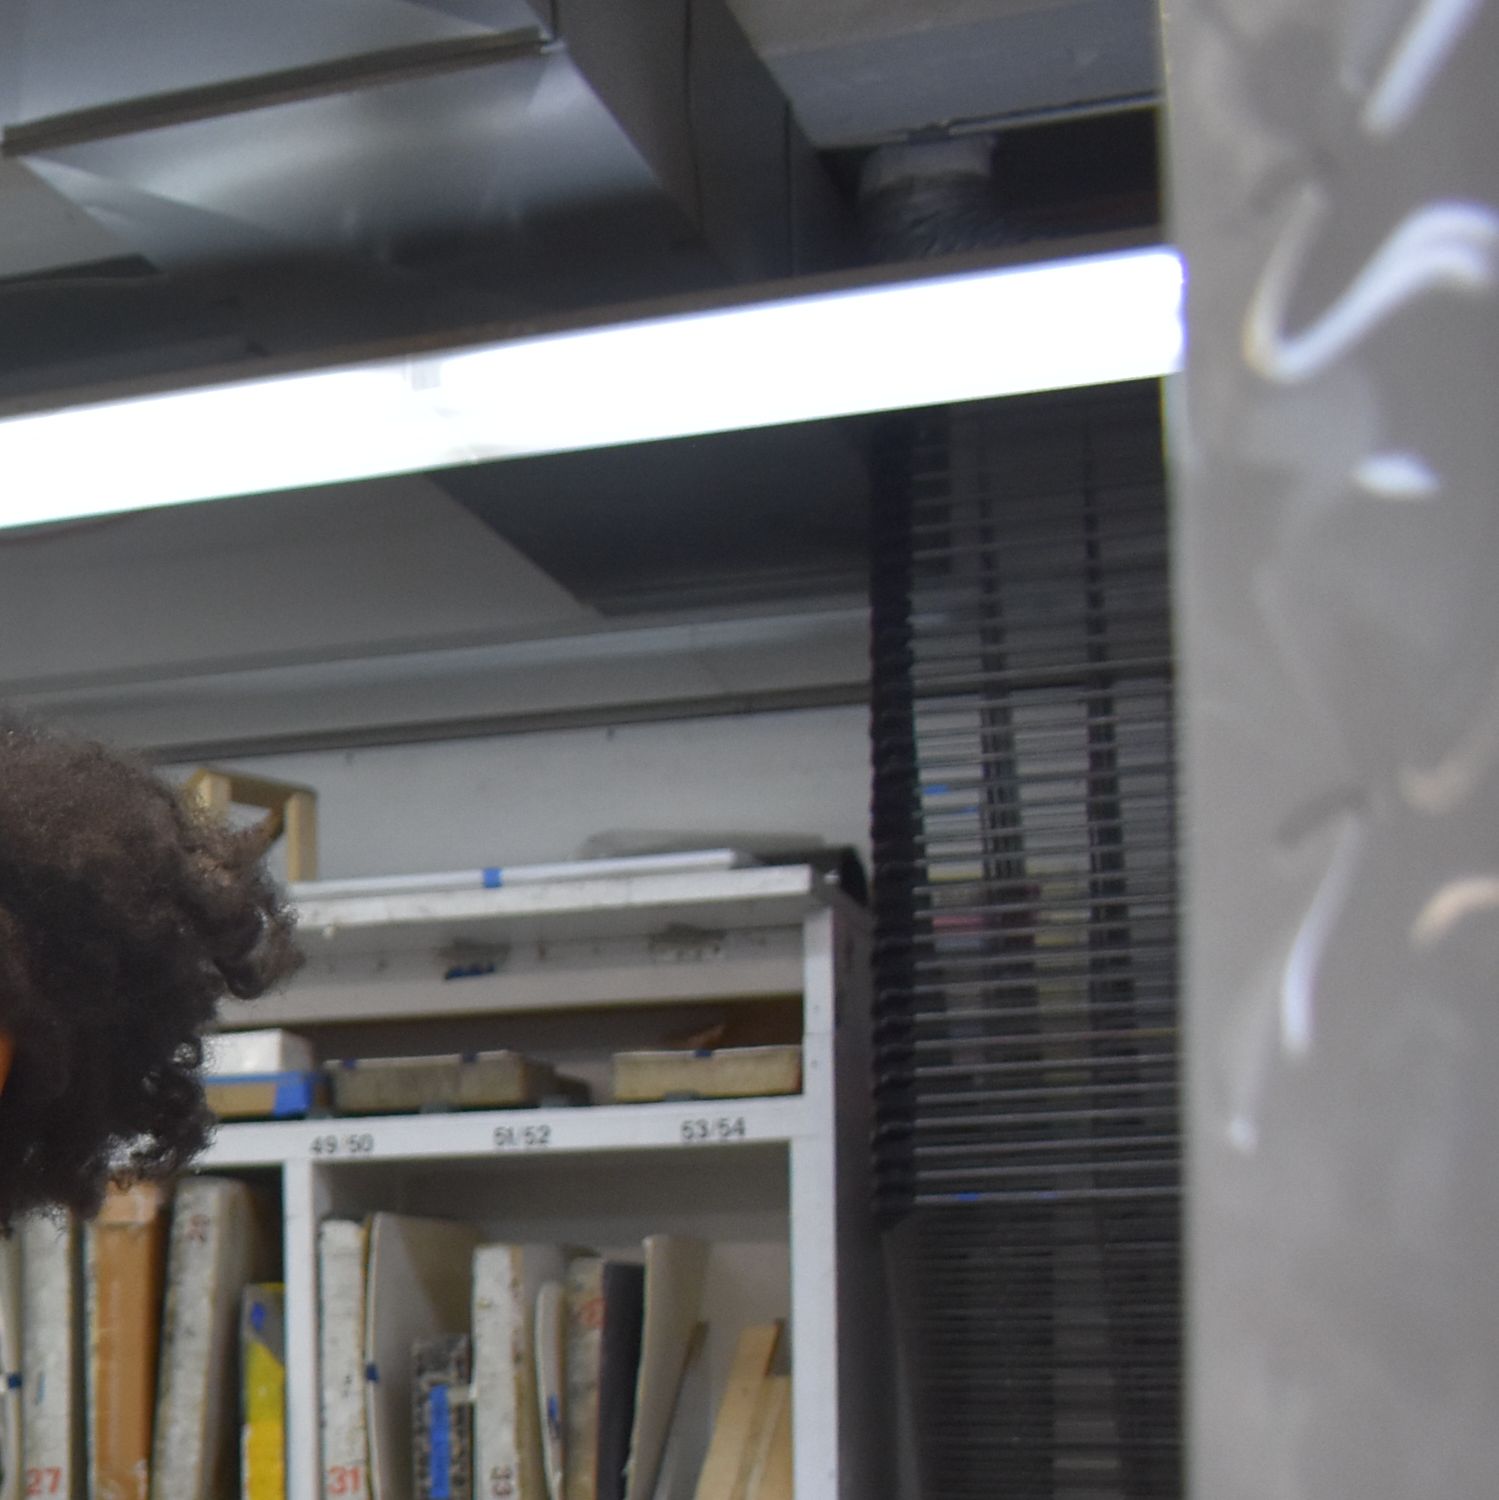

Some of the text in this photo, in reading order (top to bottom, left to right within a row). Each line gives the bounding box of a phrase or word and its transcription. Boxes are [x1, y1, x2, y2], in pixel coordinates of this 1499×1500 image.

[680, 1116, 746, 1142] 53/54
[26, 1466, 63, 1495] 27
[326, 1465, 362, 1496] 31
